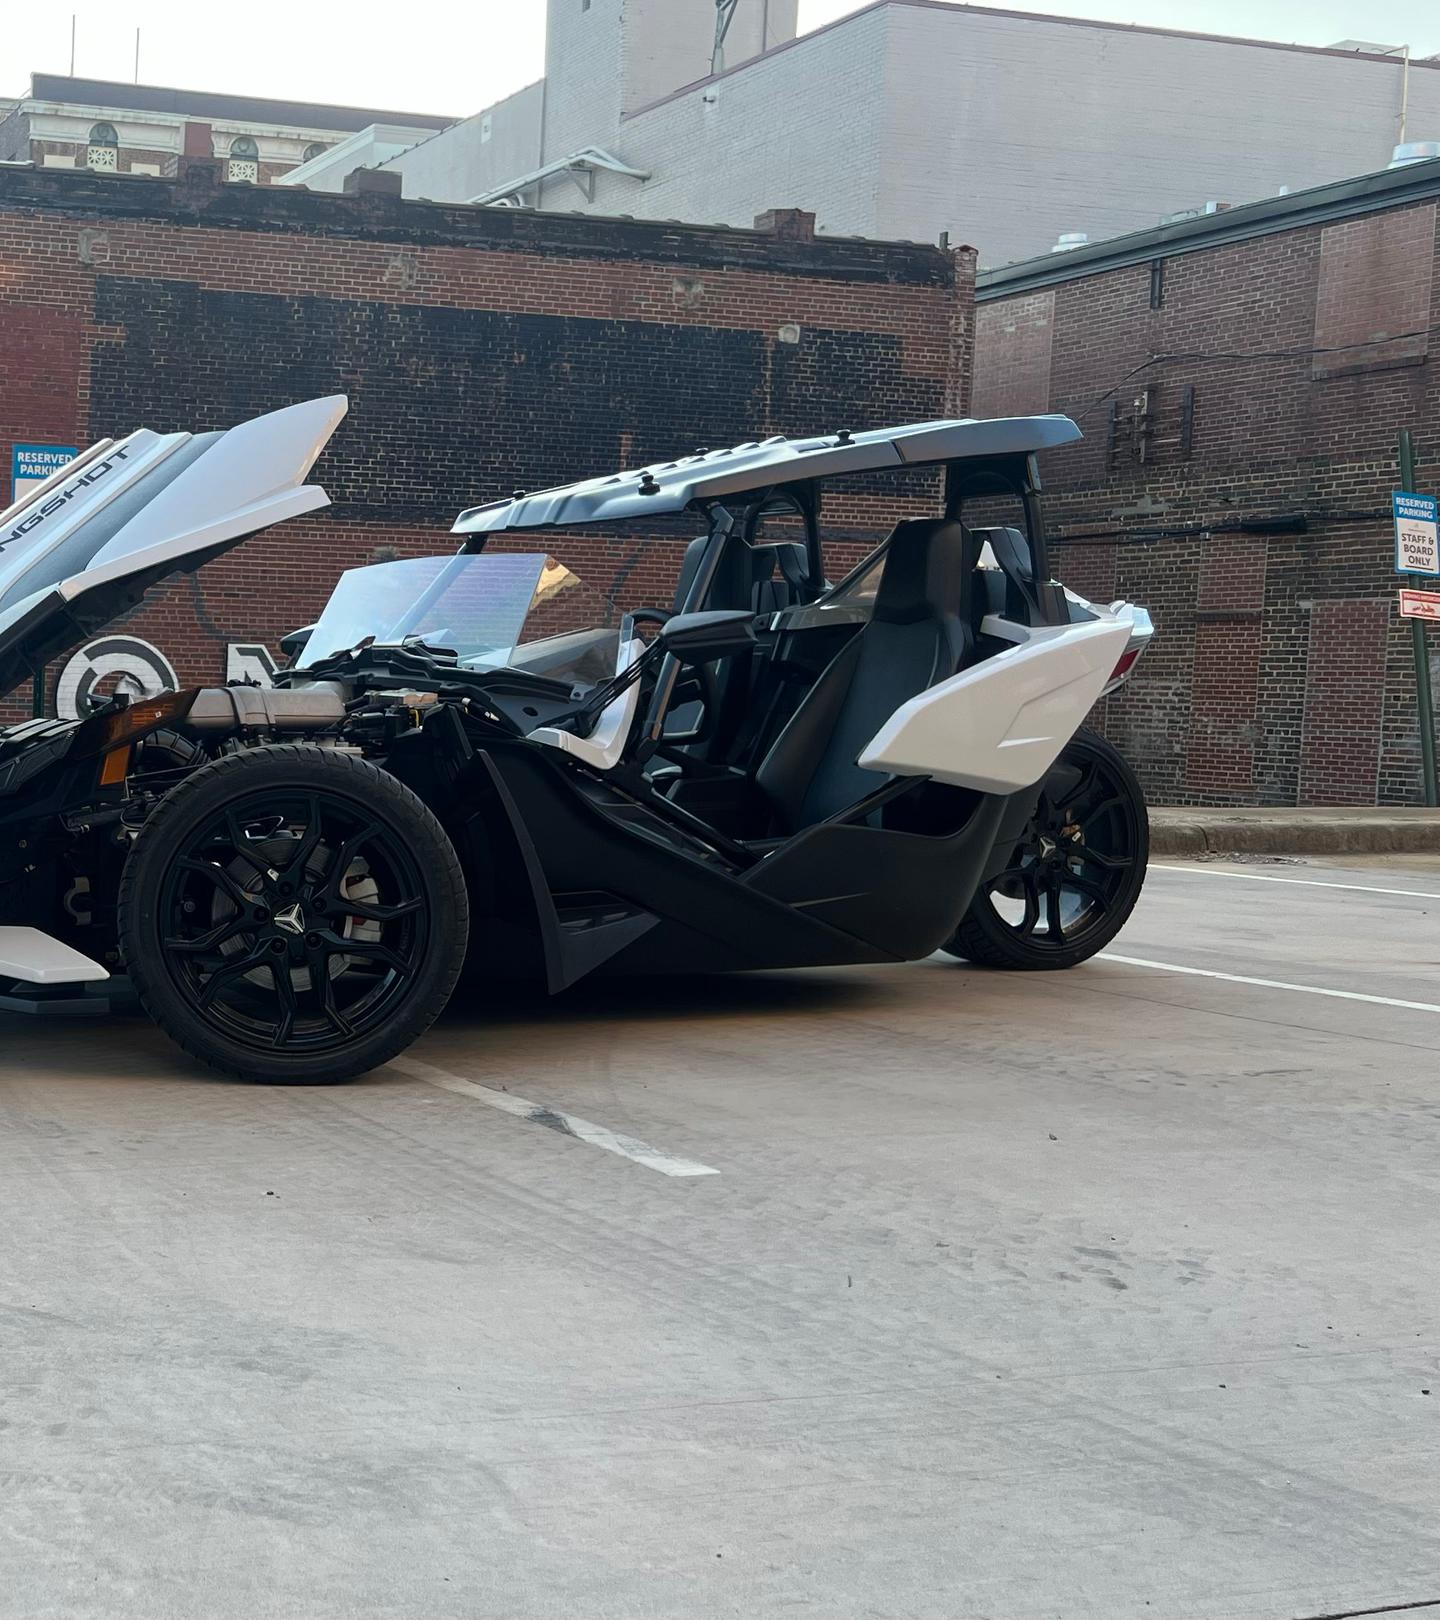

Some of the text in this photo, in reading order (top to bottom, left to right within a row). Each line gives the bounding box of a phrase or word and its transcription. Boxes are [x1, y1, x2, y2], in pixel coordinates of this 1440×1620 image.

[17, 452, 73, 464] RESERVED
[1395, 496, 1435, 510] RESERVED
[1398, 506, 1434, 519] PARKING
[1401, 533, 1427, 544] STAFF
[1403, 544, 1434, 556] BOARD
[1408, 555, 1431, 566] ONLY
